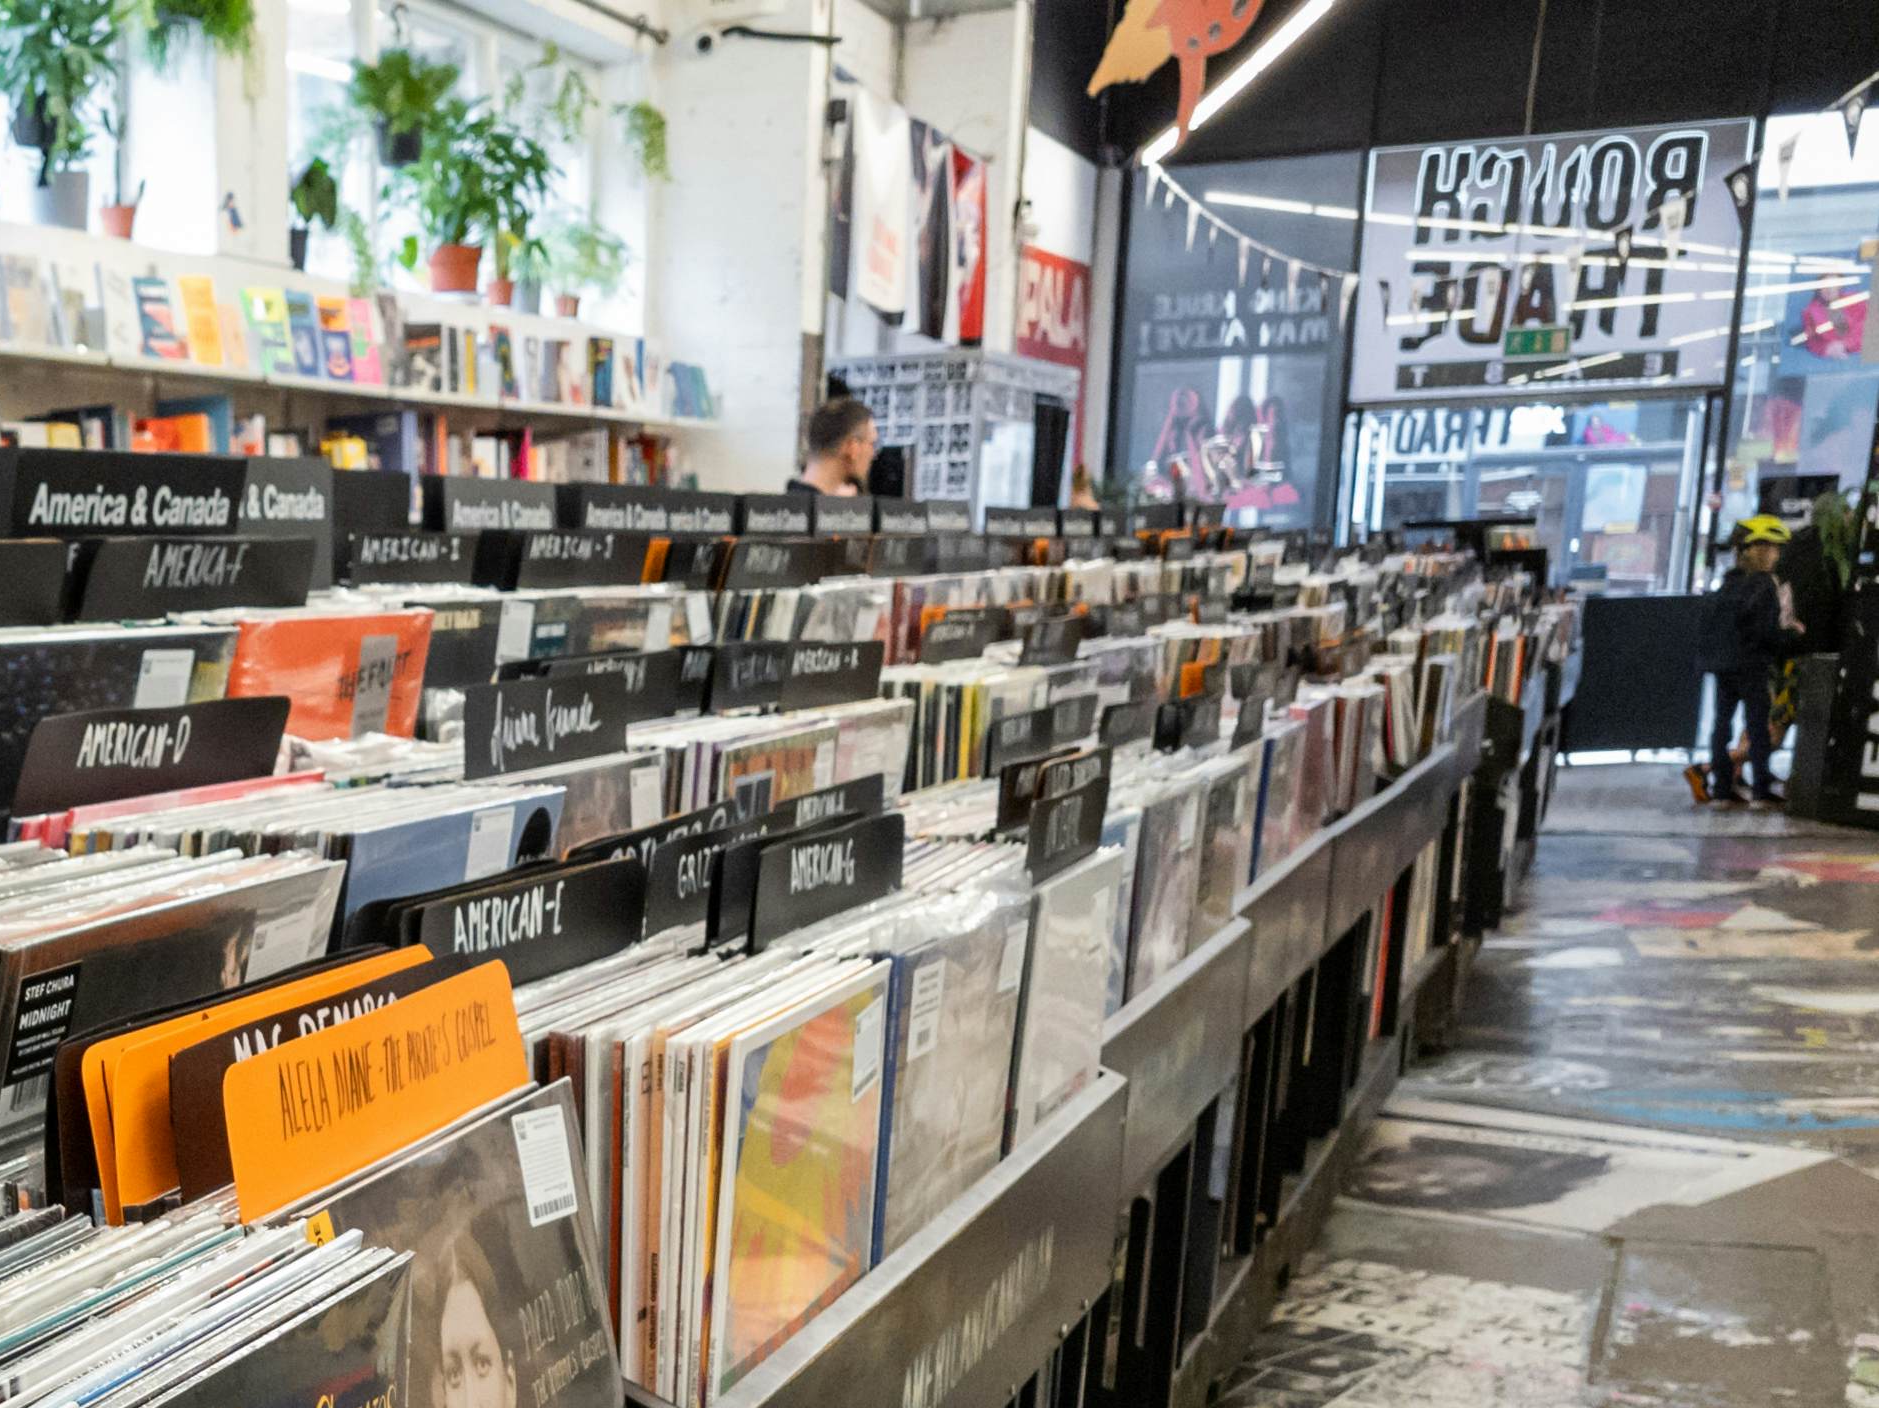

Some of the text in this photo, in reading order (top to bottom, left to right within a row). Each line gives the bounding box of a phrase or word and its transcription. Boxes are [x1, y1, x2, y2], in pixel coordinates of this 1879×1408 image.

[27, 482, 231, 526] America & Canada
[247, 484, 326, 519] & Canada
[77, 715, 190, 770] AMERICAN-D
[677, 845, 720, 900] GRIZ
[24, 974, 75, 1002] STEF CHURA
[18, 999, 72, 1031] MIDNIGHT
[277, 1056, 333, 1141] ALELA
[332, 1041, 376, 1120] DIANE
[455, 1000, 497, 1063] GOSPEL
